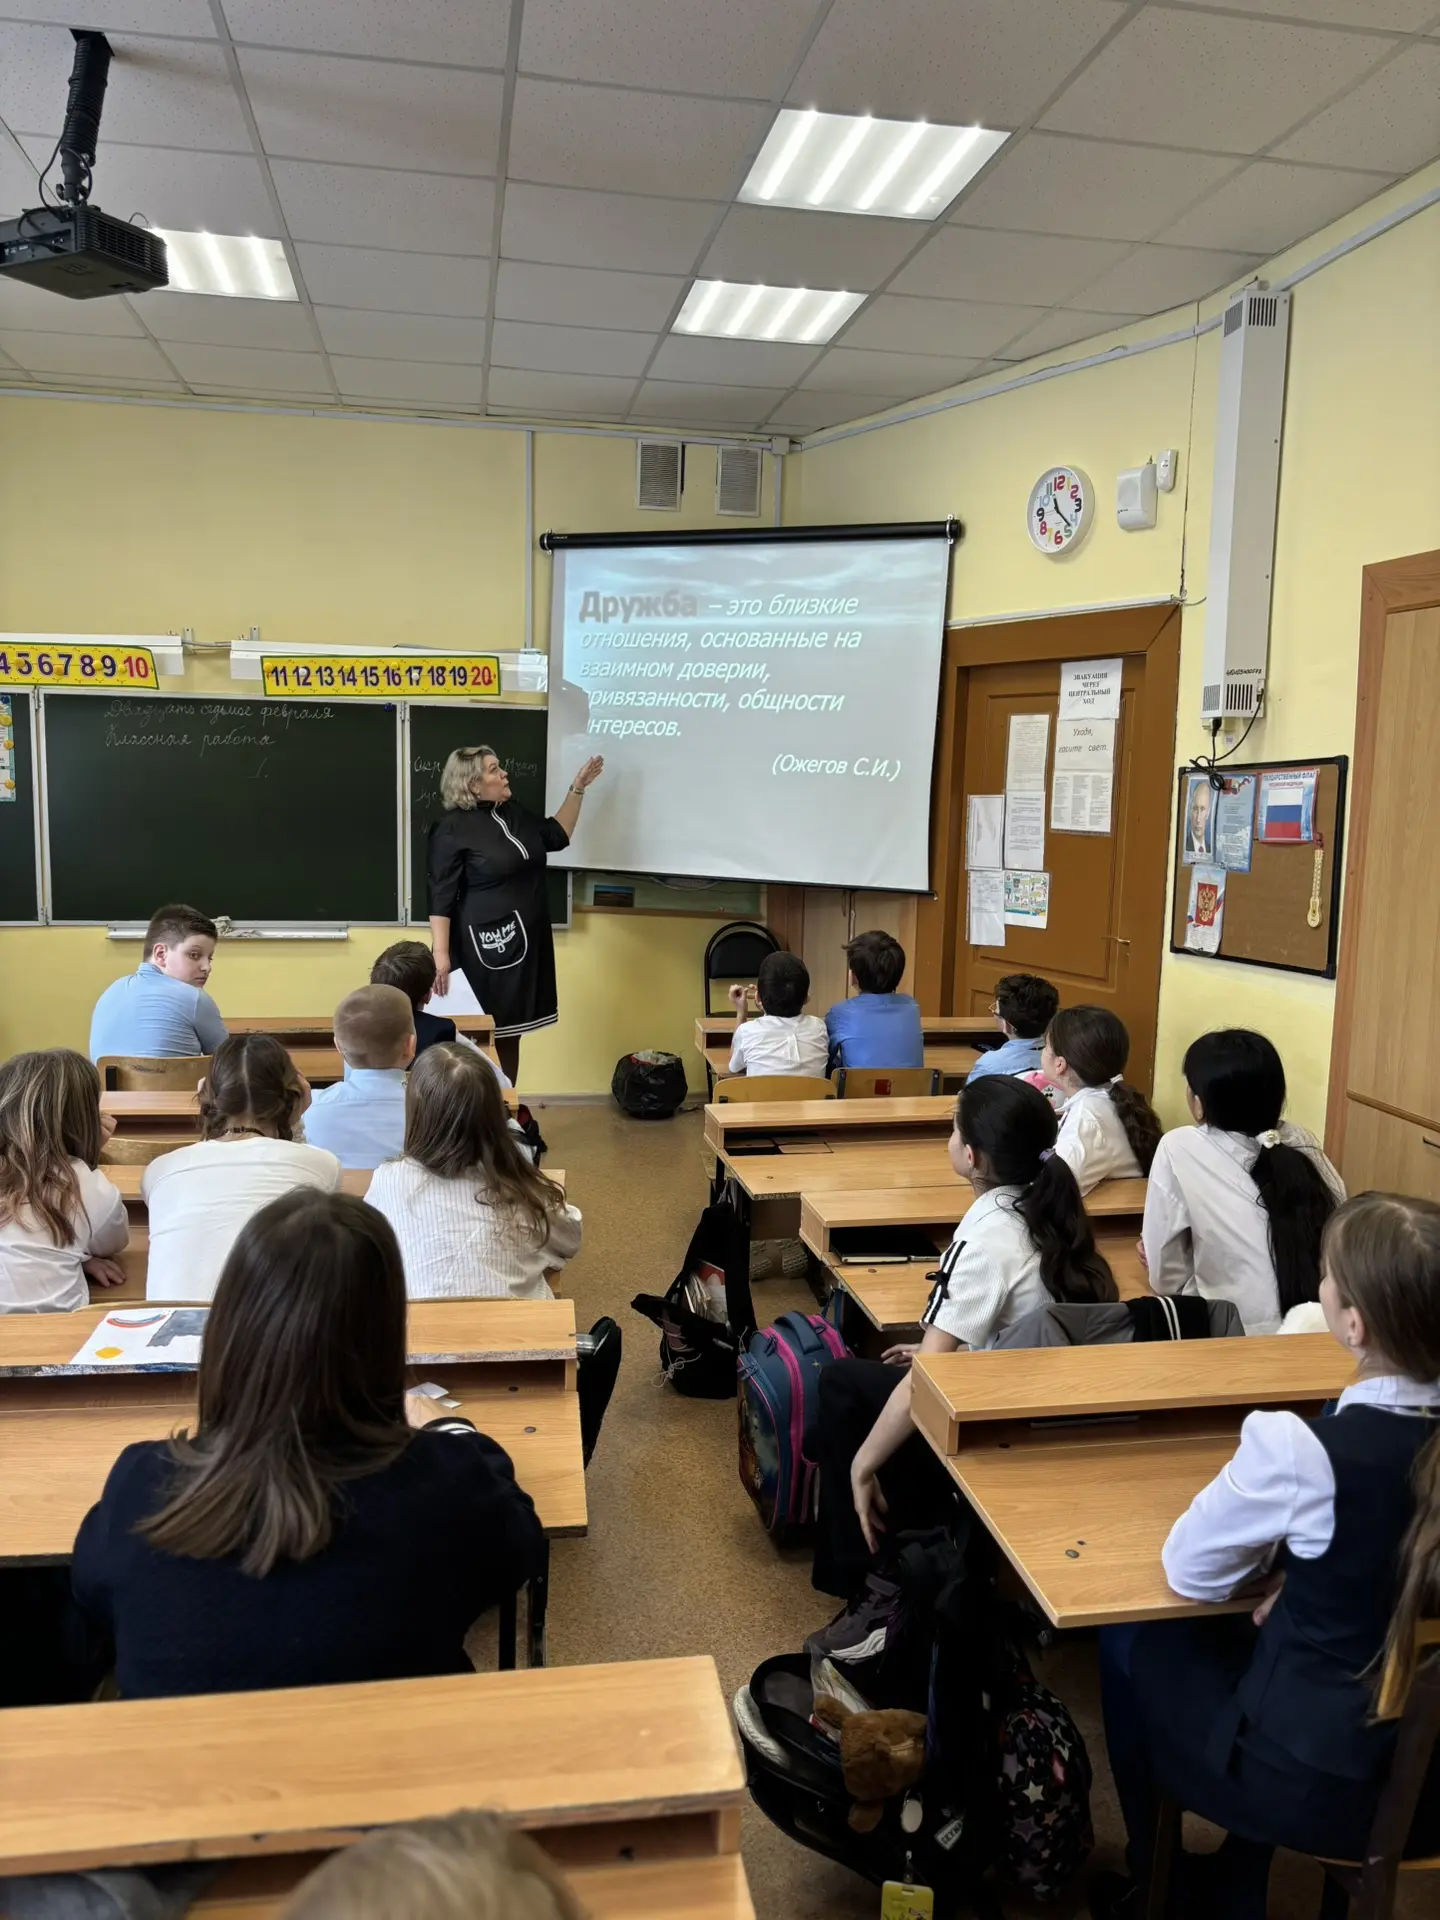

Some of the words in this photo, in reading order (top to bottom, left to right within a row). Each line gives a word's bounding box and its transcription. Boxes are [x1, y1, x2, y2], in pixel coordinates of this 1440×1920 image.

[1053, 475, 1066, 491] 12
[1070, 484, 1079, 500] 2
[1036, 507, 1045, 522] 9
[1074, 497, 1082, 513] 3
[1039, 520, 1048, 536] 8
[1054, 530, 1064, 545] 6
[578, 588, 698, 624] Дружба
[726, 599, 763, 617] это
[768, 593, 859, 616] близкие
[580, 631, 692, 652] отношения,
[700, 630, 829, 649] основанные
[833, 630, 863, 649] на
[37, 653, 54, 676] 6
[57, 653, 73, 676] 7
[80, 654, 97, 677] 8
[100, 654, 117, 677] 9
[122, 655, 149, 678] 10
[271, 665, 288, 687] 11
[292, 665, 312, 687] 12
[315, 665, 335, 687] 13
[337, 665, 358, 687] 14
[360, 665, 380, 687] 15
[382, 665, 402, 687] 16
[405, 665, 423, 687] 17
[427, 665, 447, 687] 18
[449, 665, 468, 687] 19
[471, 665, 493, 687] 20
[580, 661, 675, 678] взаимном
[676, 662, 771, 684] доверии,
[588, 690, 731, 713] ривязанности,
[738, 688, 846, 714] общности
[260, 703, 335, 730] февраля
[105, 723, 193, 748] Классная
[200, 725, 276, 758] работа
[772, 753, 848, 776] (Ожегов
[852, 757, 902, 782] С.И.)
